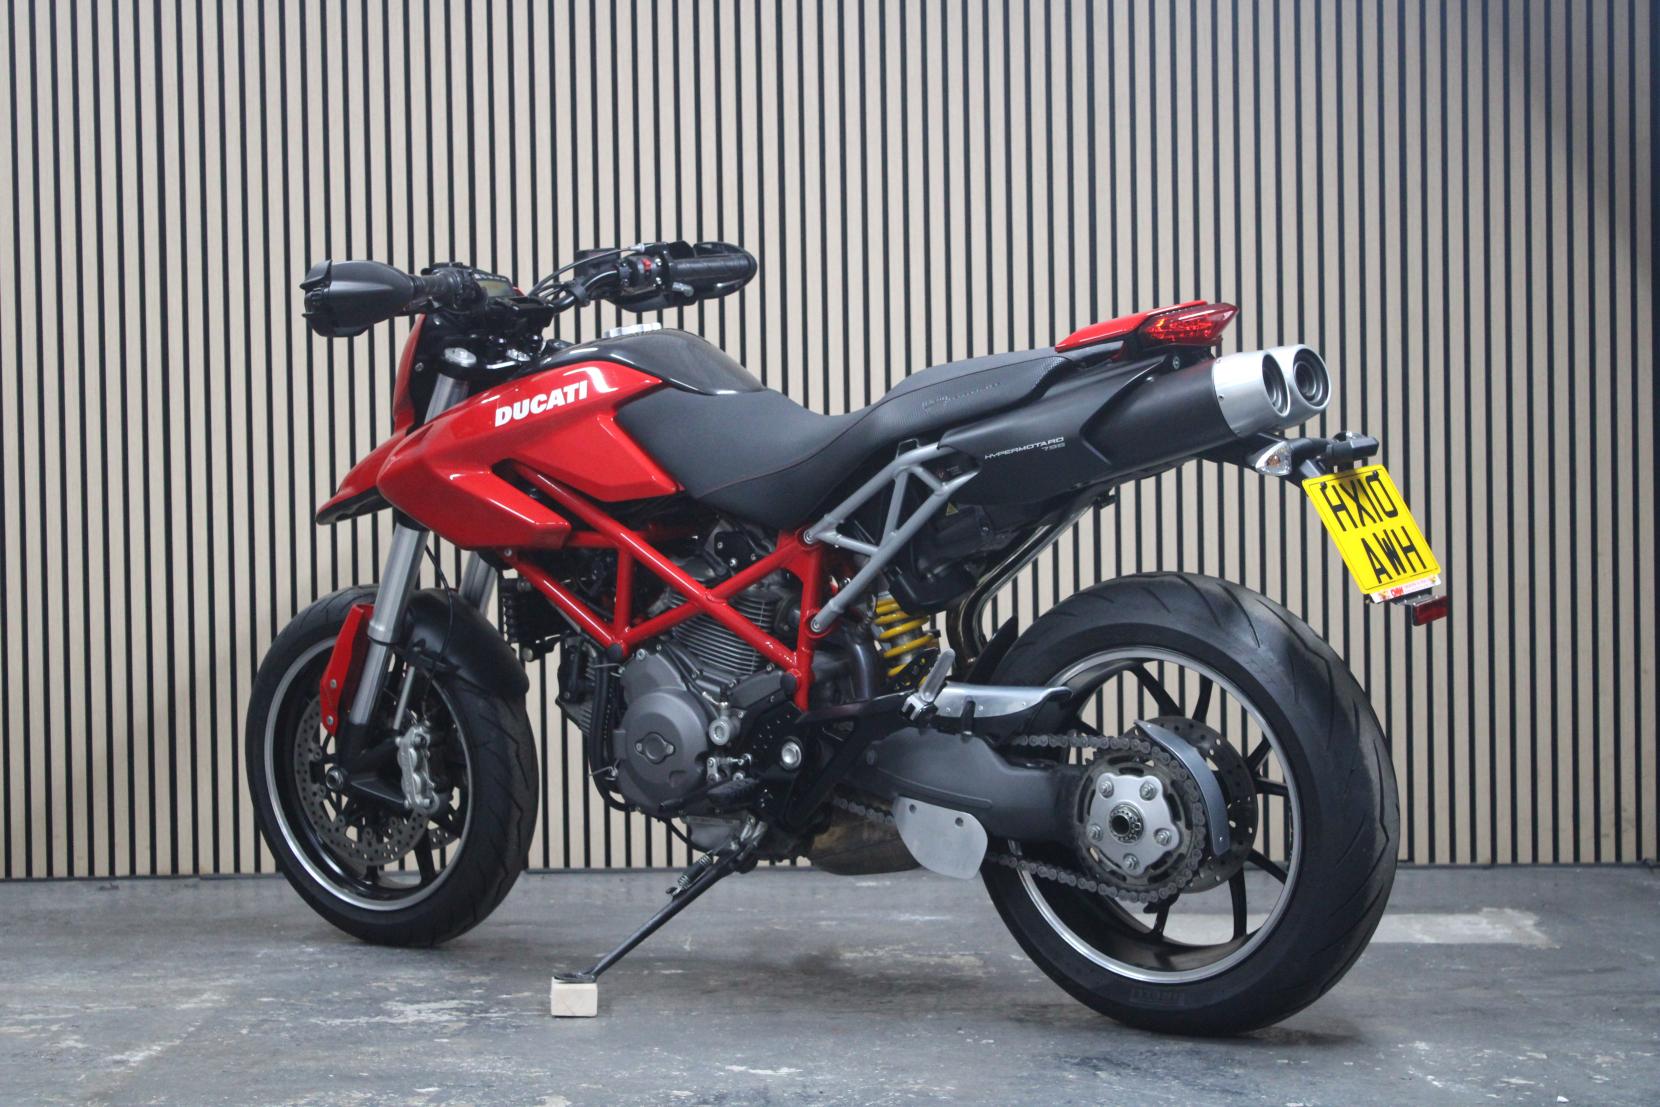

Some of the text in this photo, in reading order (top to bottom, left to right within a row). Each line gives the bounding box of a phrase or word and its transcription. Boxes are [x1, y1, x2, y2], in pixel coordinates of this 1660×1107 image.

[495, 380, 587, 427] DUCATI
[984, 436, 1064, 460] HYPERMOTARD
[1320, 473, 1398, 532] HX10
[1361, 526, 1427, 584] AWH
